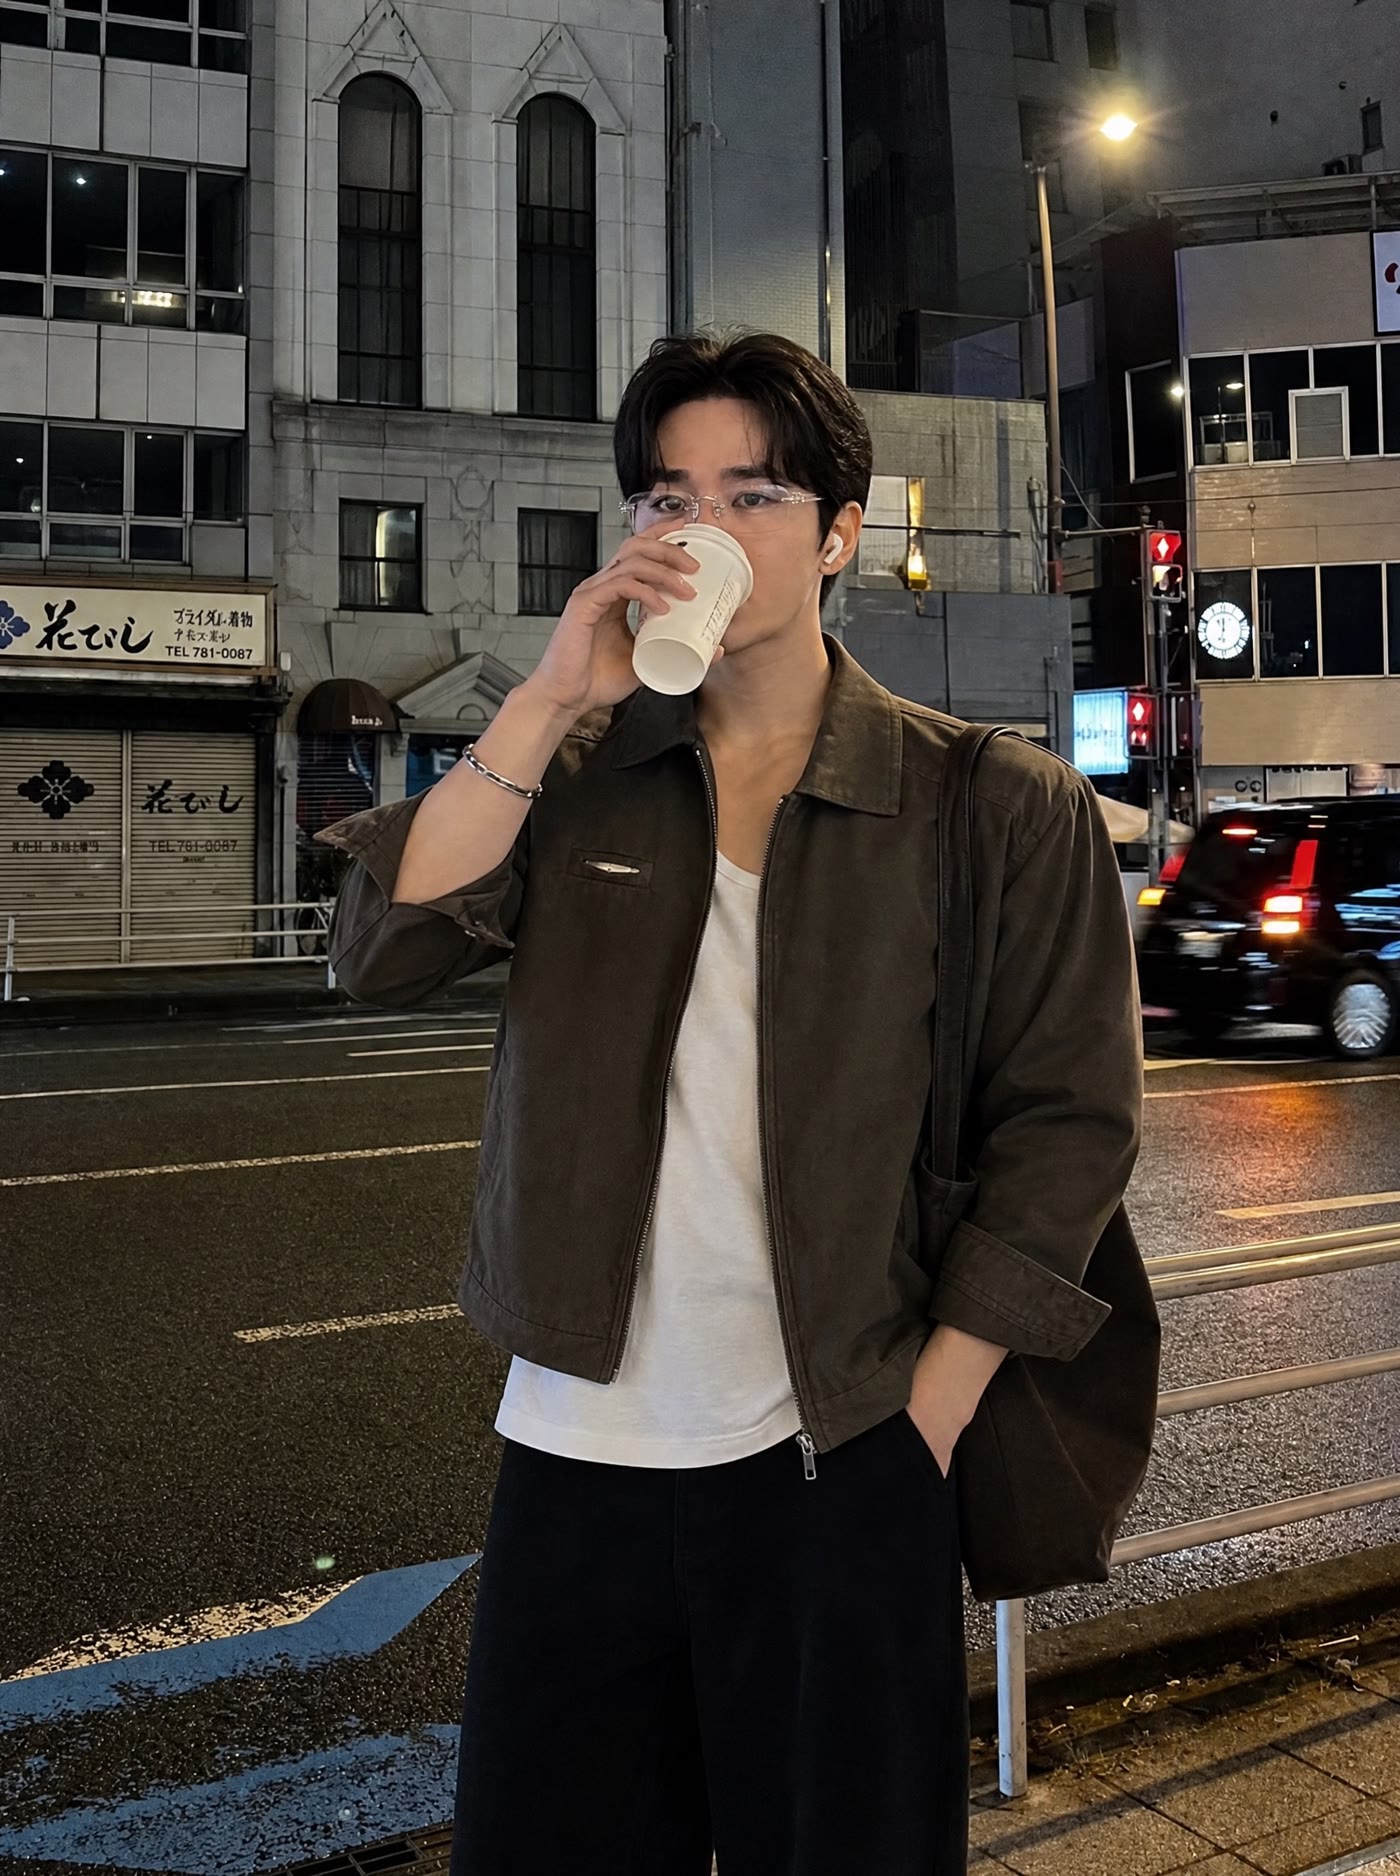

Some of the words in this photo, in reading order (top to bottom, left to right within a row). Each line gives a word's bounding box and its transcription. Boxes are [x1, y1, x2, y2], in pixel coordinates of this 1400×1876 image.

[35, 599, 154, 654] 花びし
[165, 646, 190, 657] TEL
[192, 646, 253, 660] 781-0087
[141, 779, 245, 814] 花びし
[148, 839, 175, 852] TEL
